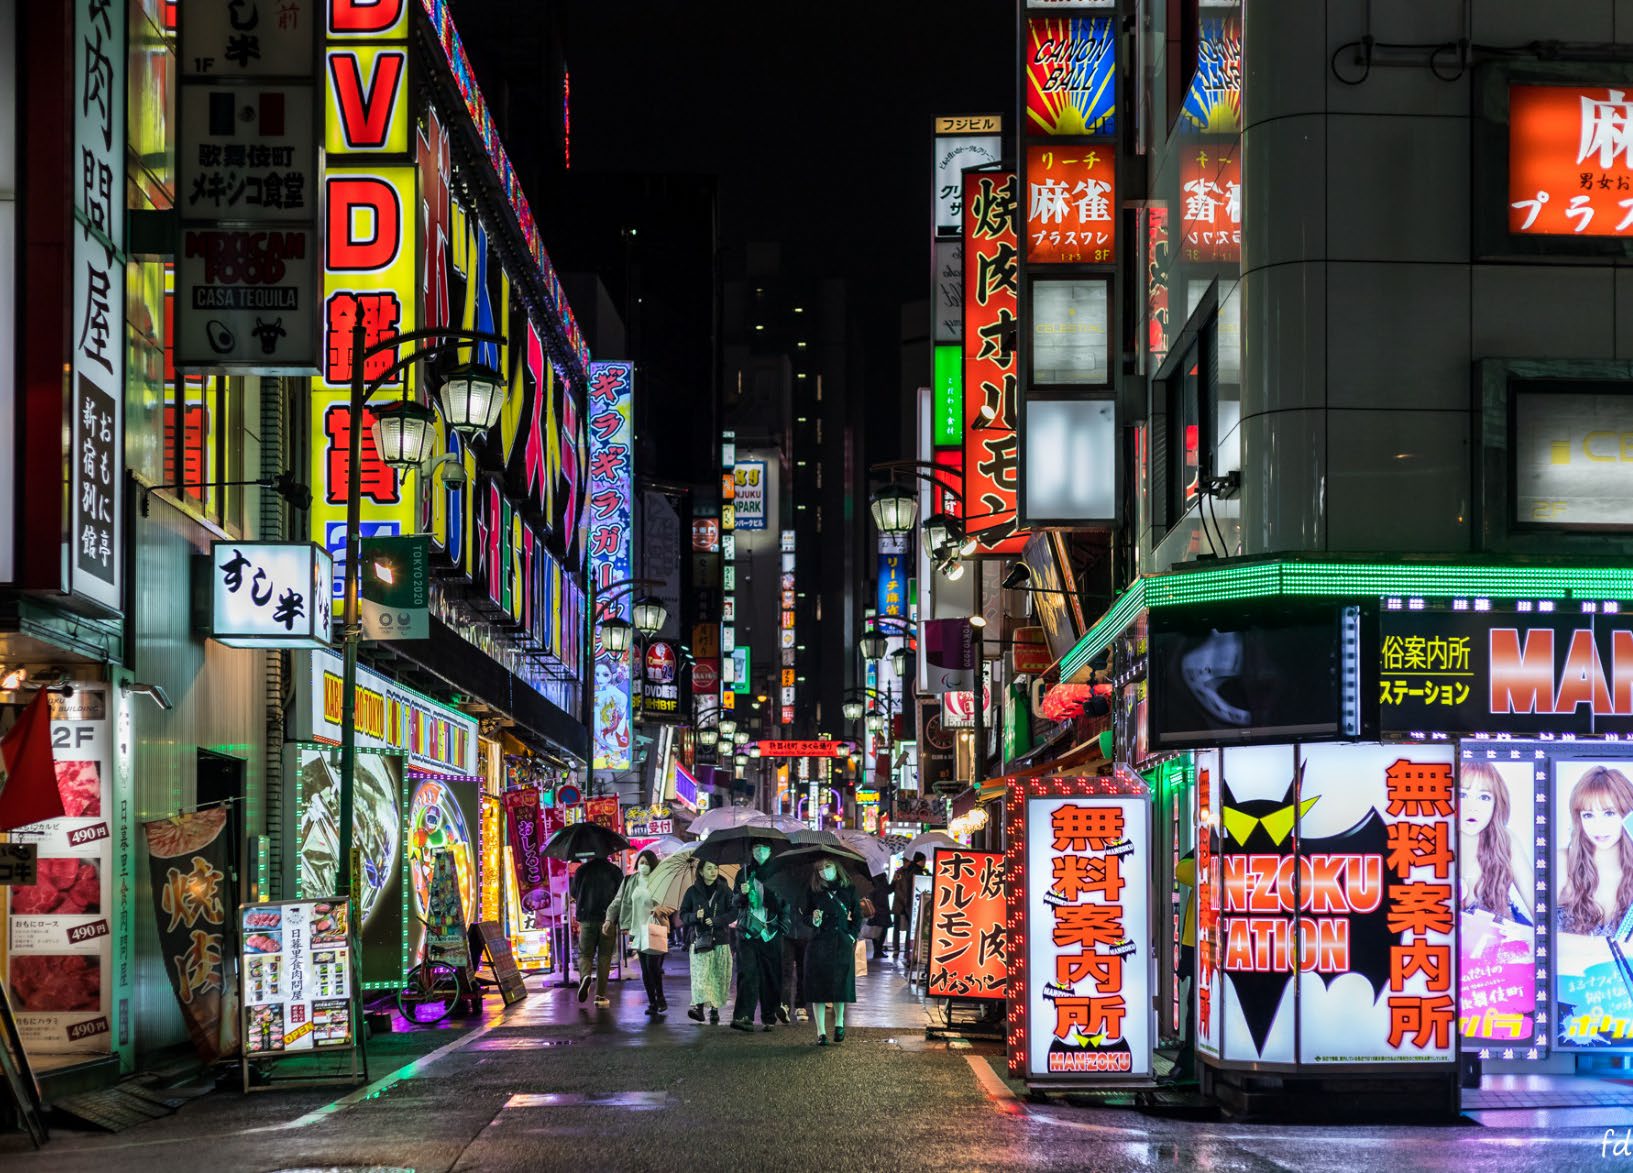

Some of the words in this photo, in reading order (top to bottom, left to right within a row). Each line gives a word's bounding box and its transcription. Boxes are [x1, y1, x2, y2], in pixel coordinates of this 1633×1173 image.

[194, 58, 215, 72] 1F
[1035, 38, 1113, 65] CANON
[1042, 67, 1097, 92] BALL
[943, 119, 994, 131] フジビル
[199, 145, 295, 167] 歌舞伎町
[1041, 151, 1101, 170] リーチ
[189, 172, 305, 210] メキシコ食堂
[1028, 178, 1112, 224] 麻雀
[185, 232, 306, 260] MEXICAN
[1031, 230, 1109, 247] プラスワン
[1094, 250, 1110, 261] 3F
[203, 254, 287, 285] FOOD
[197, 288, 235, 307] CASA
[238, 288, 296, 307] TEQUILA
[81, 396, 98, 560] 新宿別館
[98, 411, 112, 568] おもに亭
[422, 388, 478, 584] BOT
[489, 476, 587, 684] RESTAURANT
[413, 546, 422, 578] TOKYO
[413, 580, 423, 605] 2020
[52, 727, 94, 749] 2F
[71, 825, 107, 845] 490円
[649, 821, 671, 833] 受付
[518, 820, 542, 883] おしるこ
[935, 853, 975, 964] ホルモン
[1386, 758, 1458, 1050] 無料案内所
[71, 923, 107, 941] 490円
[161, 857, 226, 1004] 焼肉
[1050, 804, 1127, 1041] 無料案内所
[291, 928, 304, 1001] 日暮里食肉問屋
[284, 1022, 314, 1044] OPEN
